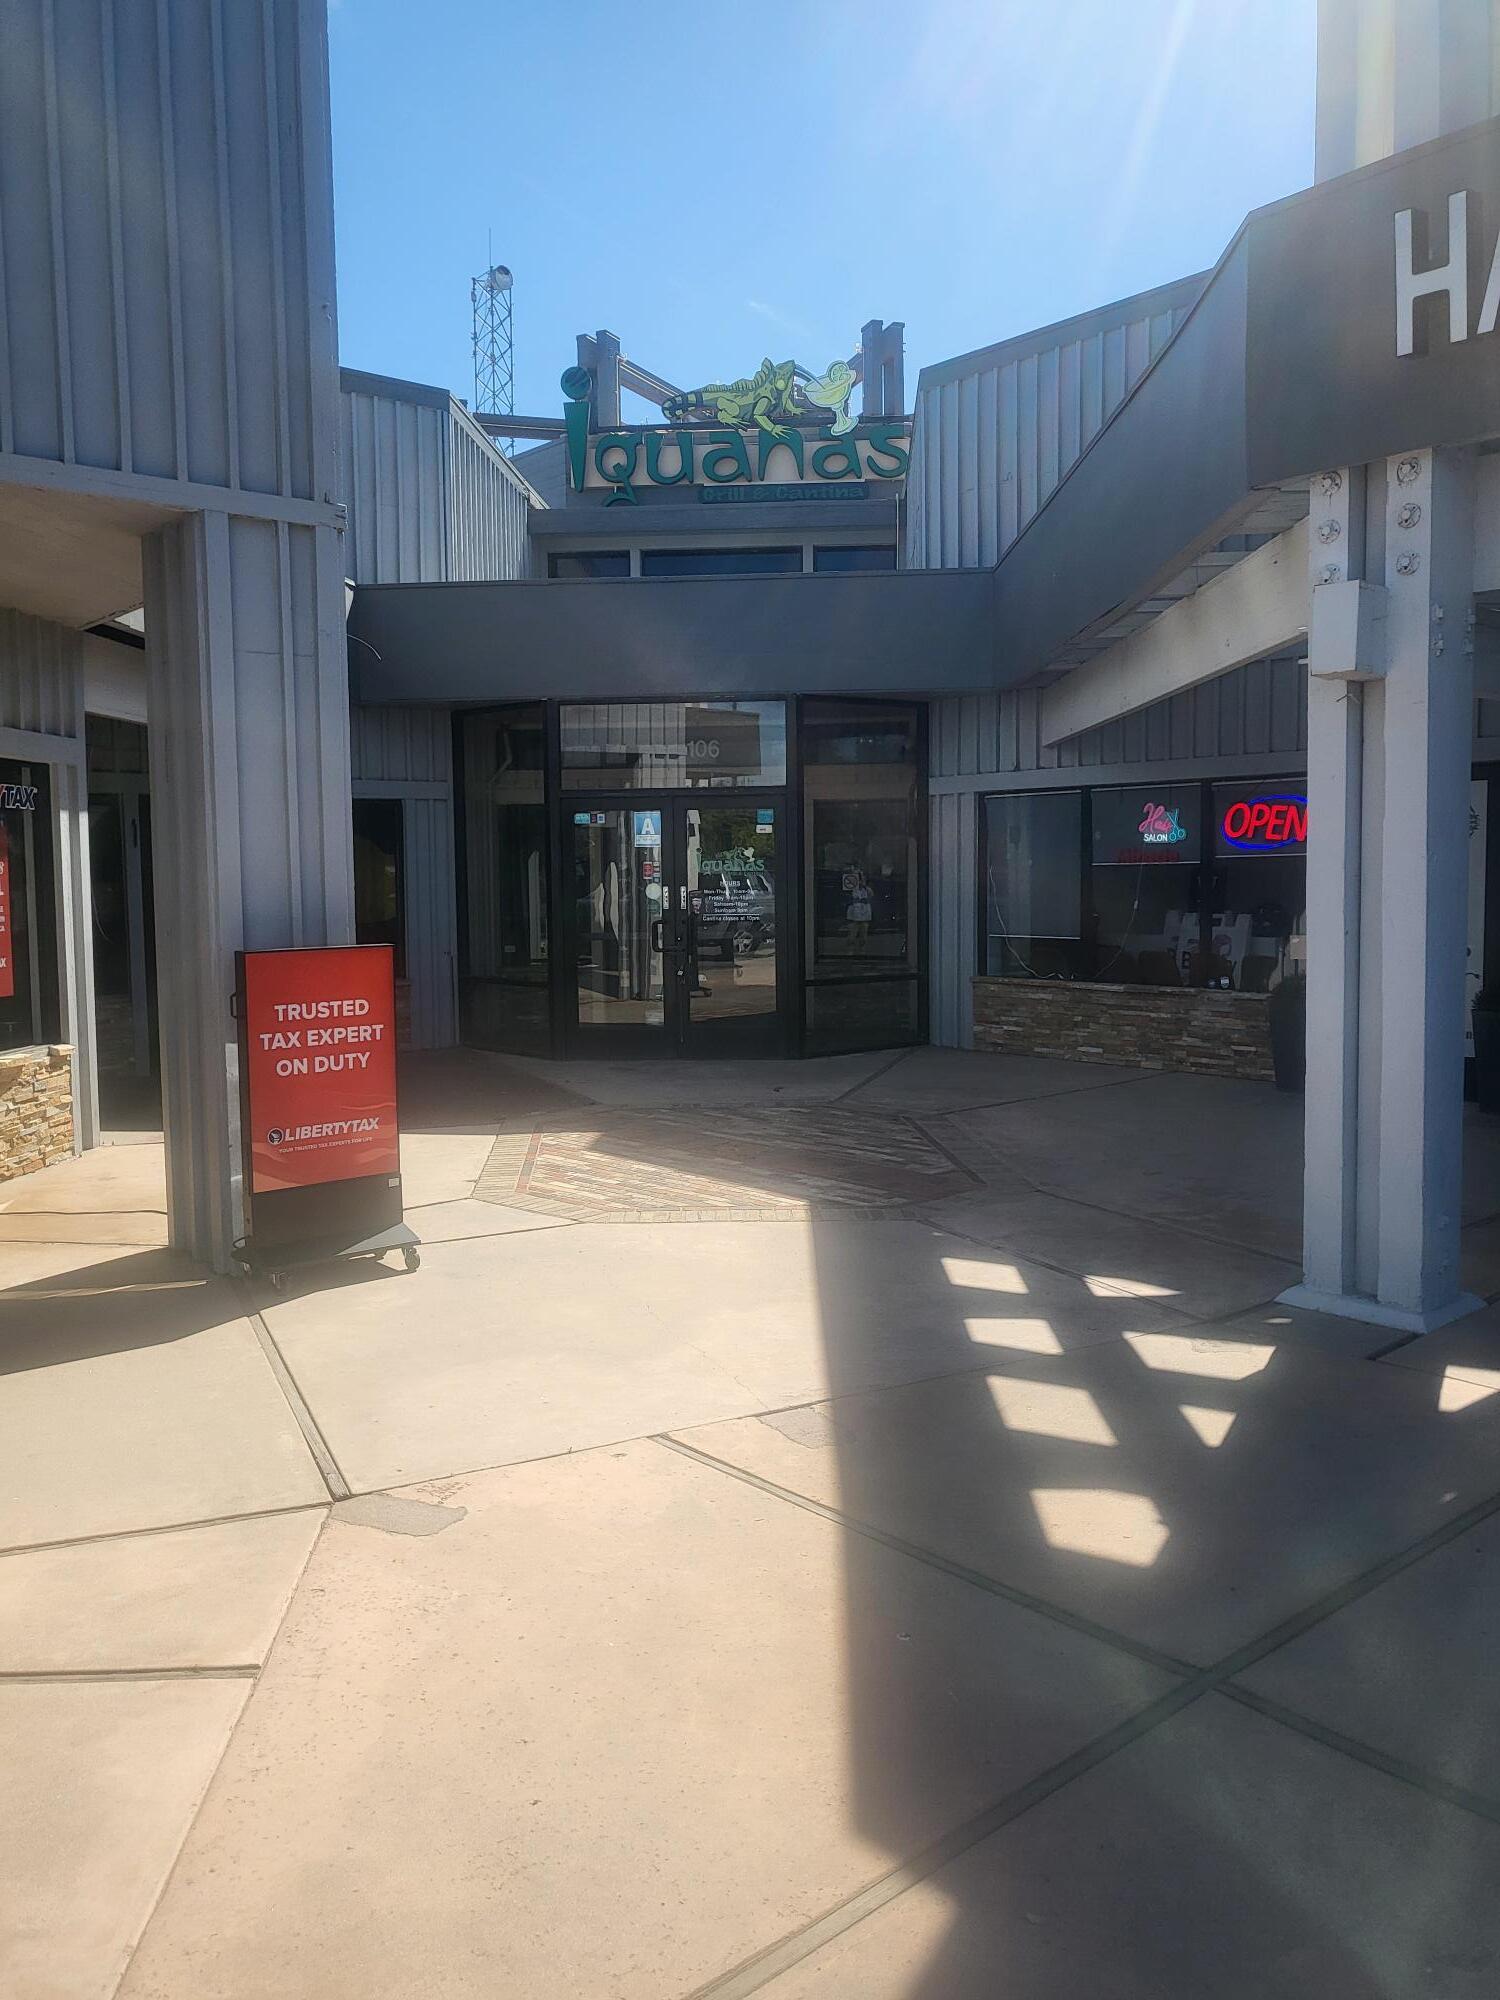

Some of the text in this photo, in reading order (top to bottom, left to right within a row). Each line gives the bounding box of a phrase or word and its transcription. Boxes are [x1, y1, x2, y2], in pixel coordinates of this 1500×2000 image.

[1394, 190, 1500, 357] H
[776, 485, 865, 501] Cantina
[686, 740, 720, 758] 106
[1224, 801, 1309, 842] OPEN
[1143, 833, 1169, 842] SALON
[275, 1000, 369, 1021] TRUSTED
[259, 1025, 383, 1051] TAX EXPERT
[275, 1052, 371, 1077] ON DUTY
[294, 1144, 318, 1152] TRUSTED
